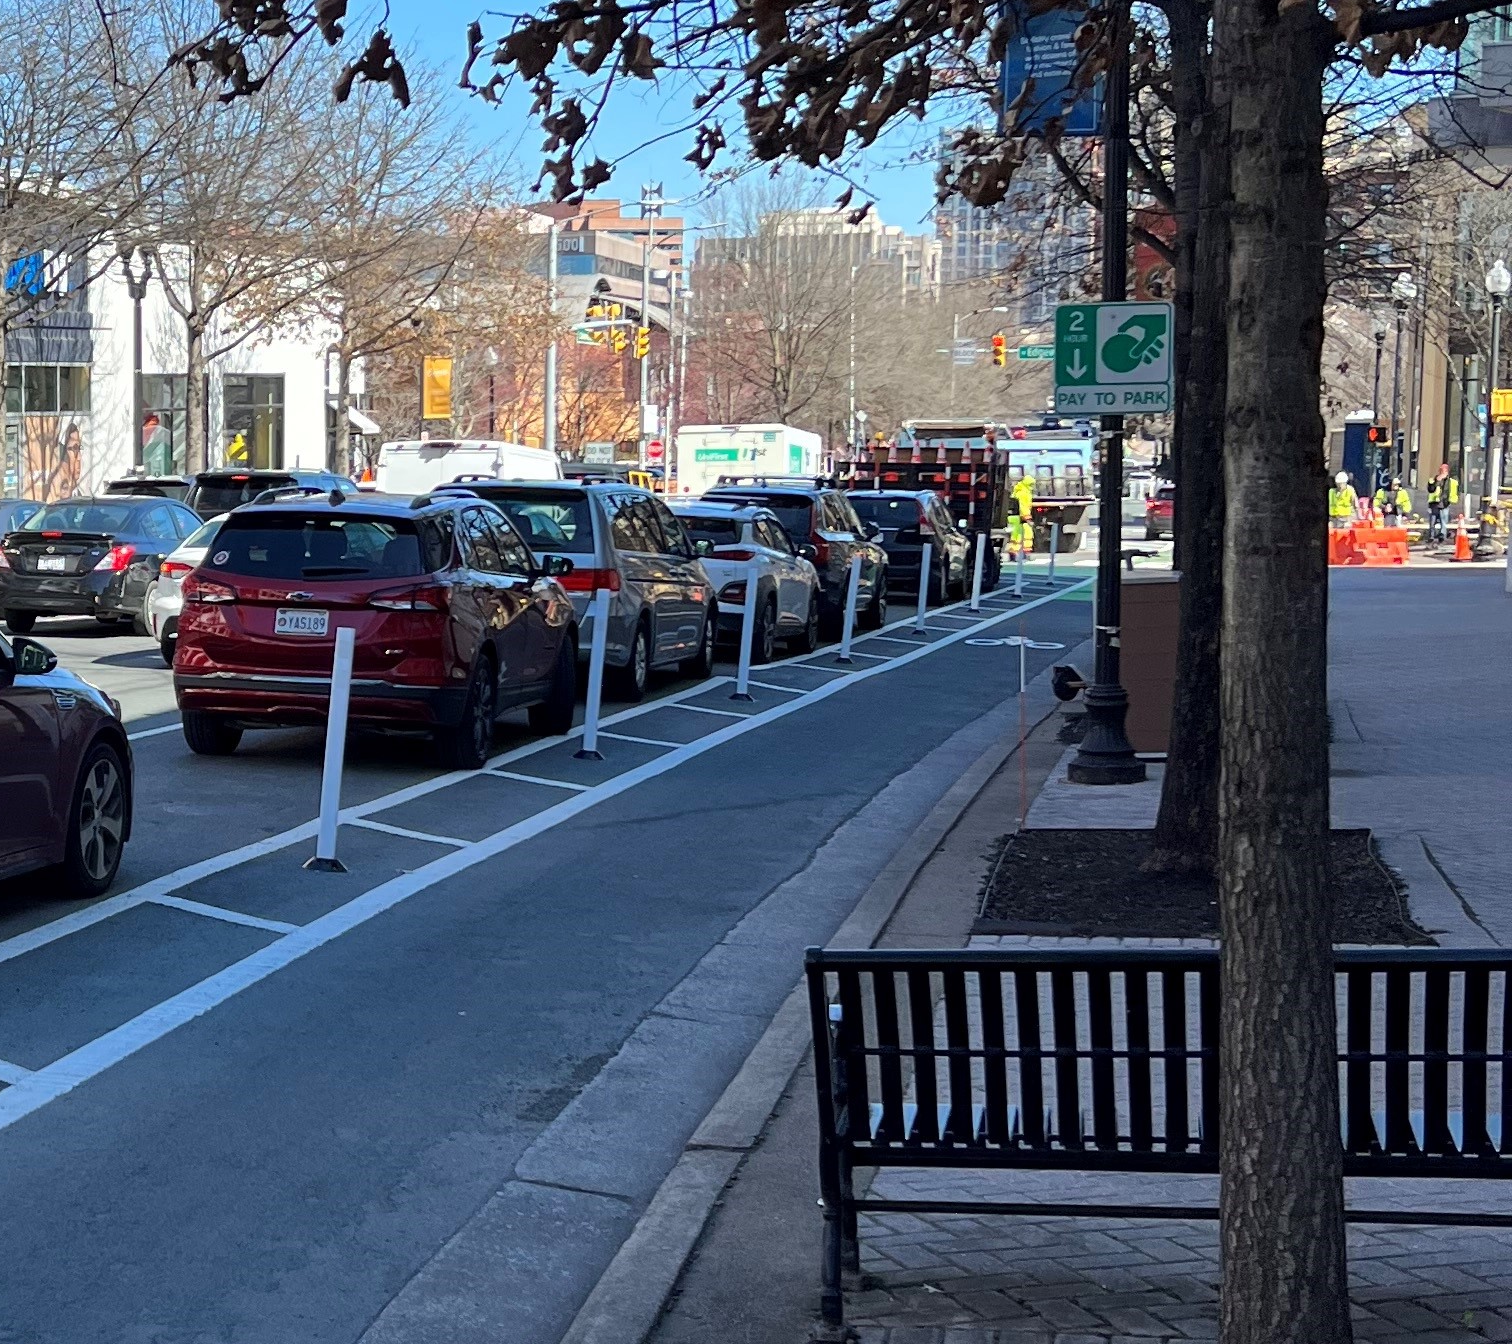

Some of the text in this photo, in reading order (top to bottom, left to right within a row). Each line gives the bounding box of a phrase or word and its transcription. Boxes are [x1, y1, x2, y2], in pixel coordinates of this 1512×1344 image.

[1069, 311, 1085, 332] 2
[1063, 334, 1088, 343] HOUR
[1058, 390, 1167, 406] PAY TO PARK
